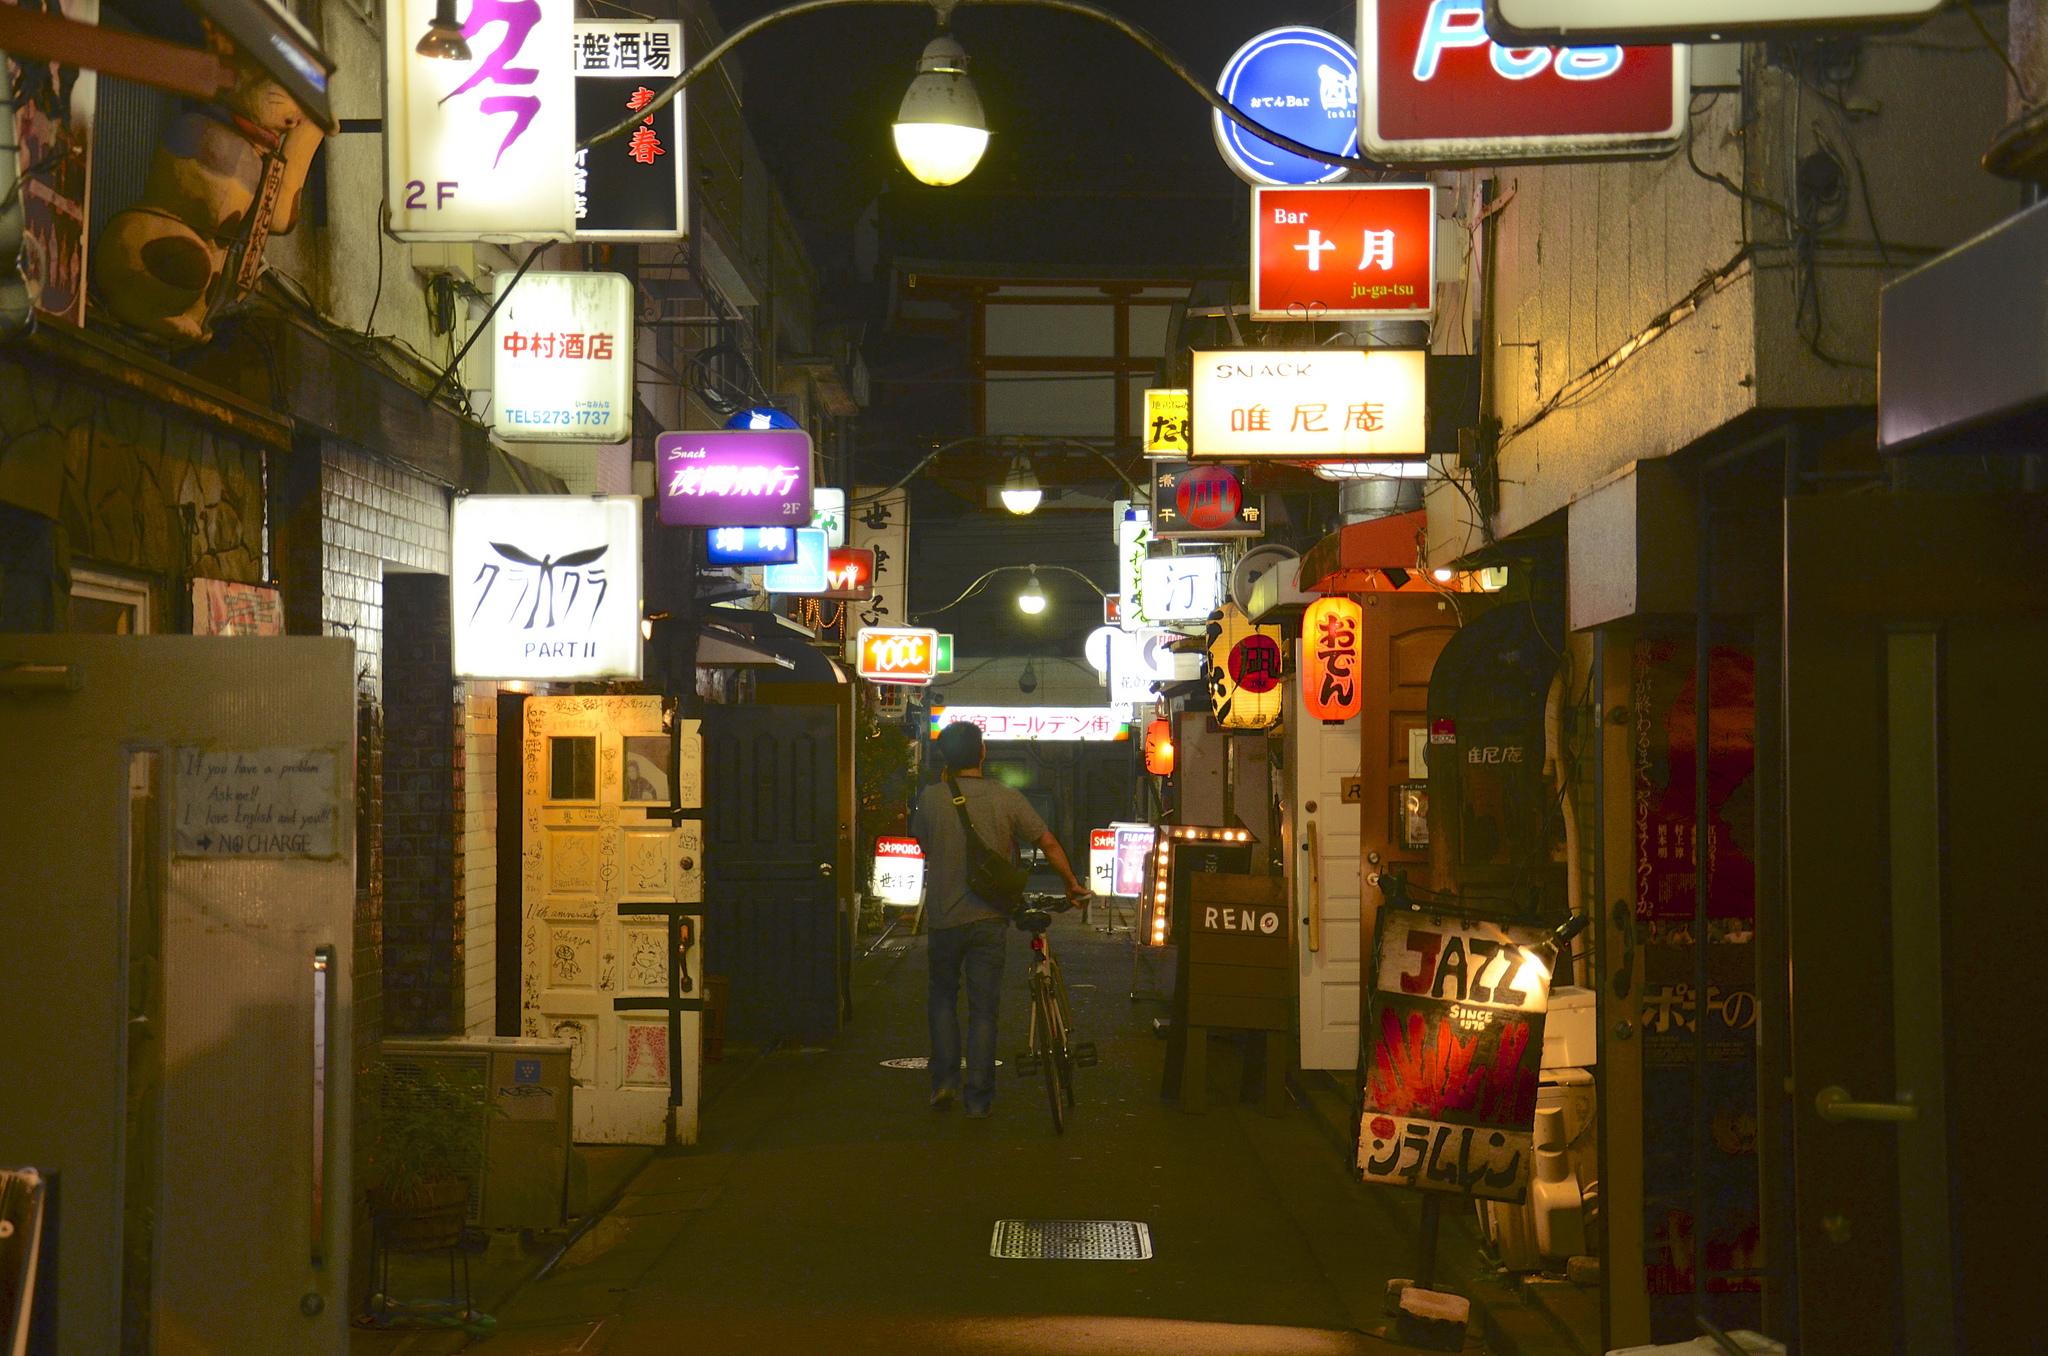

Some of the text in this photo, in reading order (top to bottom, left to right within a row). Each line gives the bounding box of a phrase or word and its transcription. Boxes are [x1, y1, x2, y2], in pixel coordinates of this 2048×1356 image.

[574, 32, 671, 70] 盤酒場
[405, 180, 459, 210] 2F
[1274, 208, 1308, 224] Bar
[1351, 281, 1415, 299] ju-ga-tsu
[503, 331, 614, 361] 中村酒店
[1216, 363, 1313, 380] SNACK
[1230, 402, 1386, 434] 唯尼庵
[668, 446, 707, 460] Snack
[782, 502, 801, 515] 2F
[1164, 564, 1200, 613] 汀
[525, 641, 596, 658] PART II
[1317, 614, 1356, 706] おでん
[207, 764, 227, 782] you
[235, 756, 257, 774] have
[206, 805, 228, 824] love
[235, 804, 272, 829] English
[247, 835, 311, 853] CHARGE
[1205, 906, 1279, 934] RENO
[1400, 930, 1527, 1007] JAZZ
[1450, 1004, 1493, 1023] SINCE
